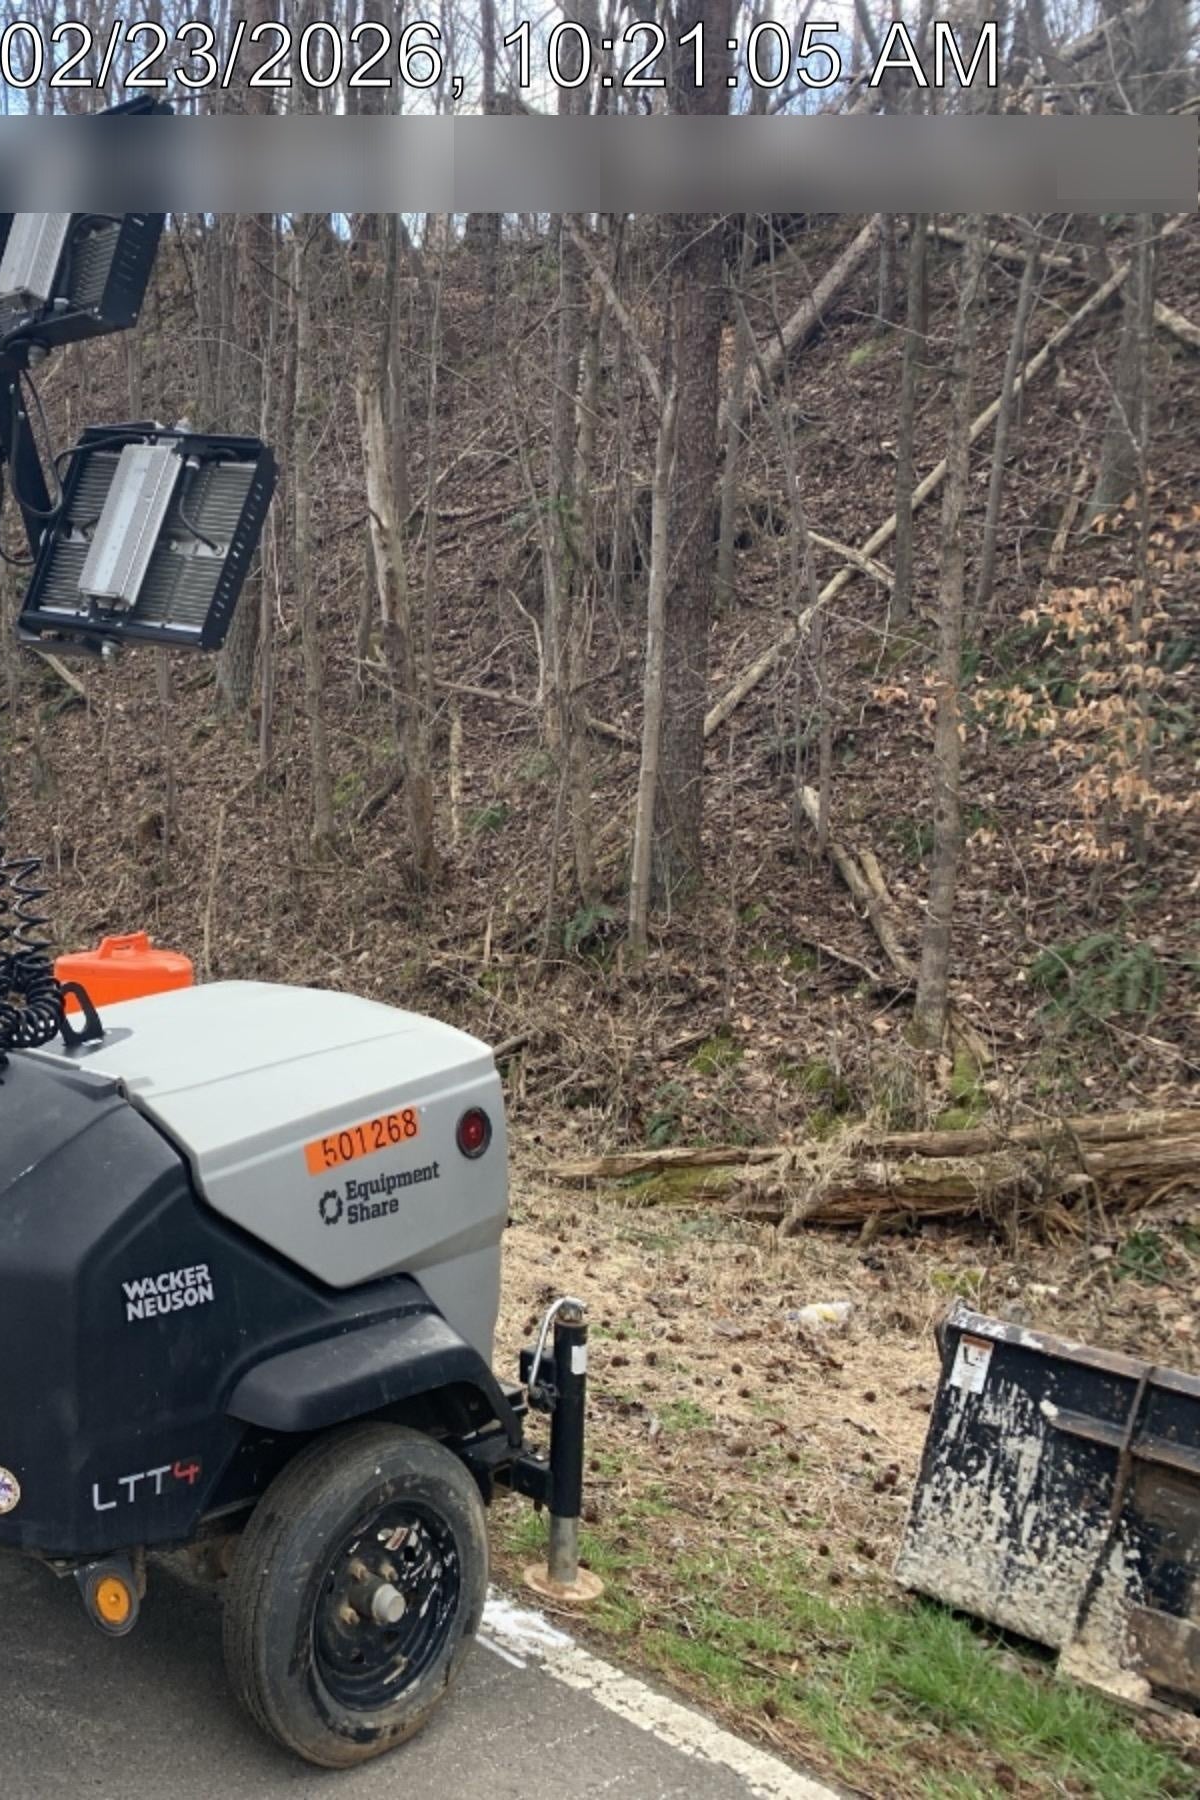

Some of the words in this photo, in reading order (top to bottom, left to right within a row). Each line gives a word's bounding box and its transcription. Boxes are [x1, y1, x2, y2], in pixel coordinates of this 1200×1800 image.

[321, 1108, 418, 1168] 501268
[345, 1160, 440, 1201] Equipment
[347, 1197, 400, 1225] Share
[121, 1263, 212, 1301] WACKER
[125, 1282, 214, 1322] NEUSON
